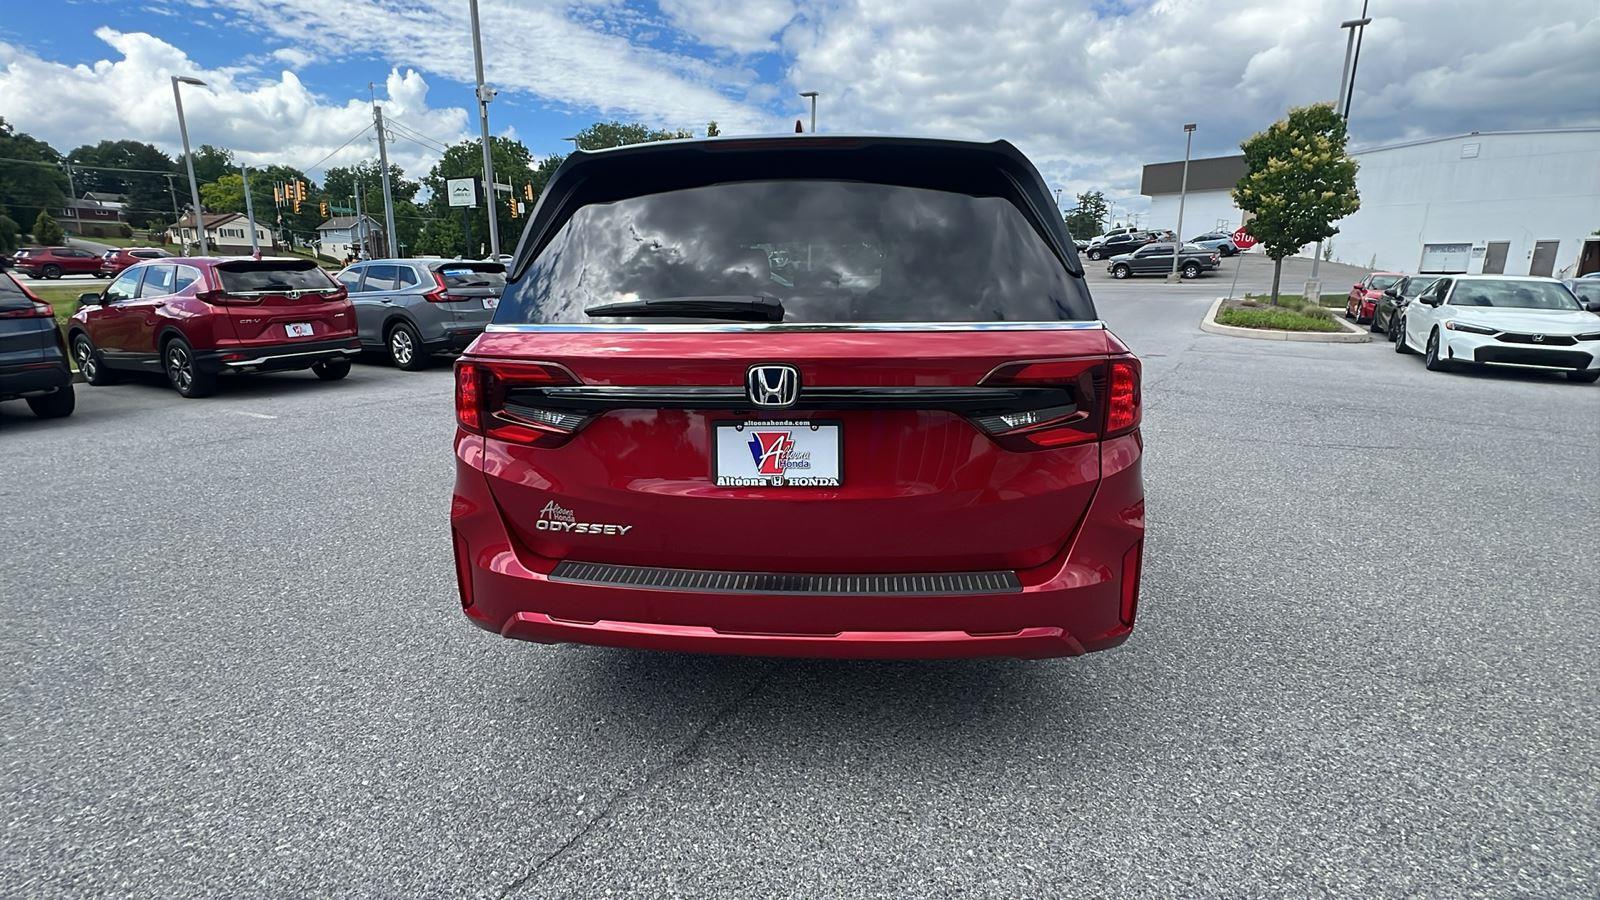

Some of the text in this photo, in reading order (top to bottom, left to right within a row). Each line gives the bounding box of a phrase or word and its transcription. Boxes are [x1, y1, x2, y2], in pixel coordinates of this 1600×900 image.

[1235, 232, 1254, 242] STO
[779, 460, 810, 468] Honda
[716, 476, 767, 486] Altoona
[788, 477, 840, 486] HONDA
[536, 520, 633, 535] ODYSSEY
